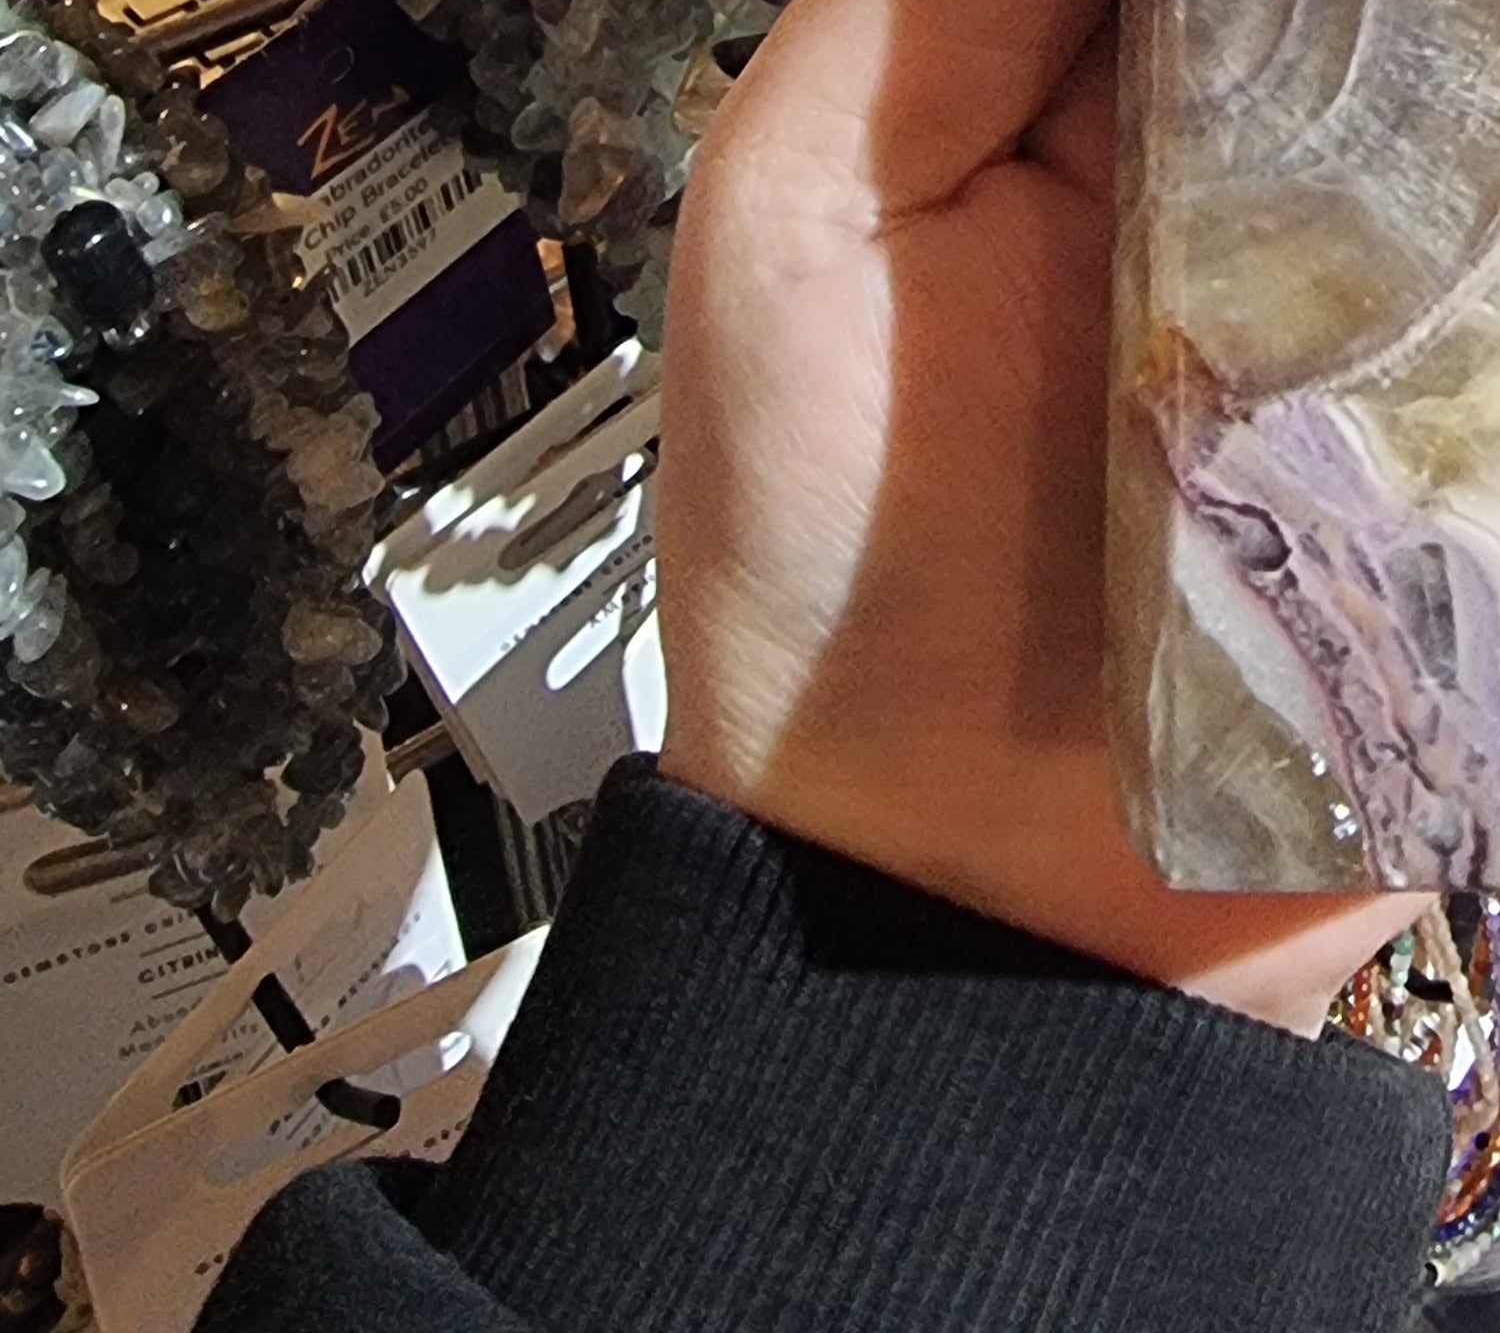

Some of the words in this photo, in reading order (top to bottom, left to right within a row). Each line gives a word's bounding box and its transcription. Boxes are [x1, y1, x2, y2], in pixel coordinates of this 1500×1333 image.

[296, 85, 411, 182] ZEN
[379, 176, 428, 224] £5.00
[303, 203, 357, 251] Chip
[138, 943, 221, 985] CITRIN
